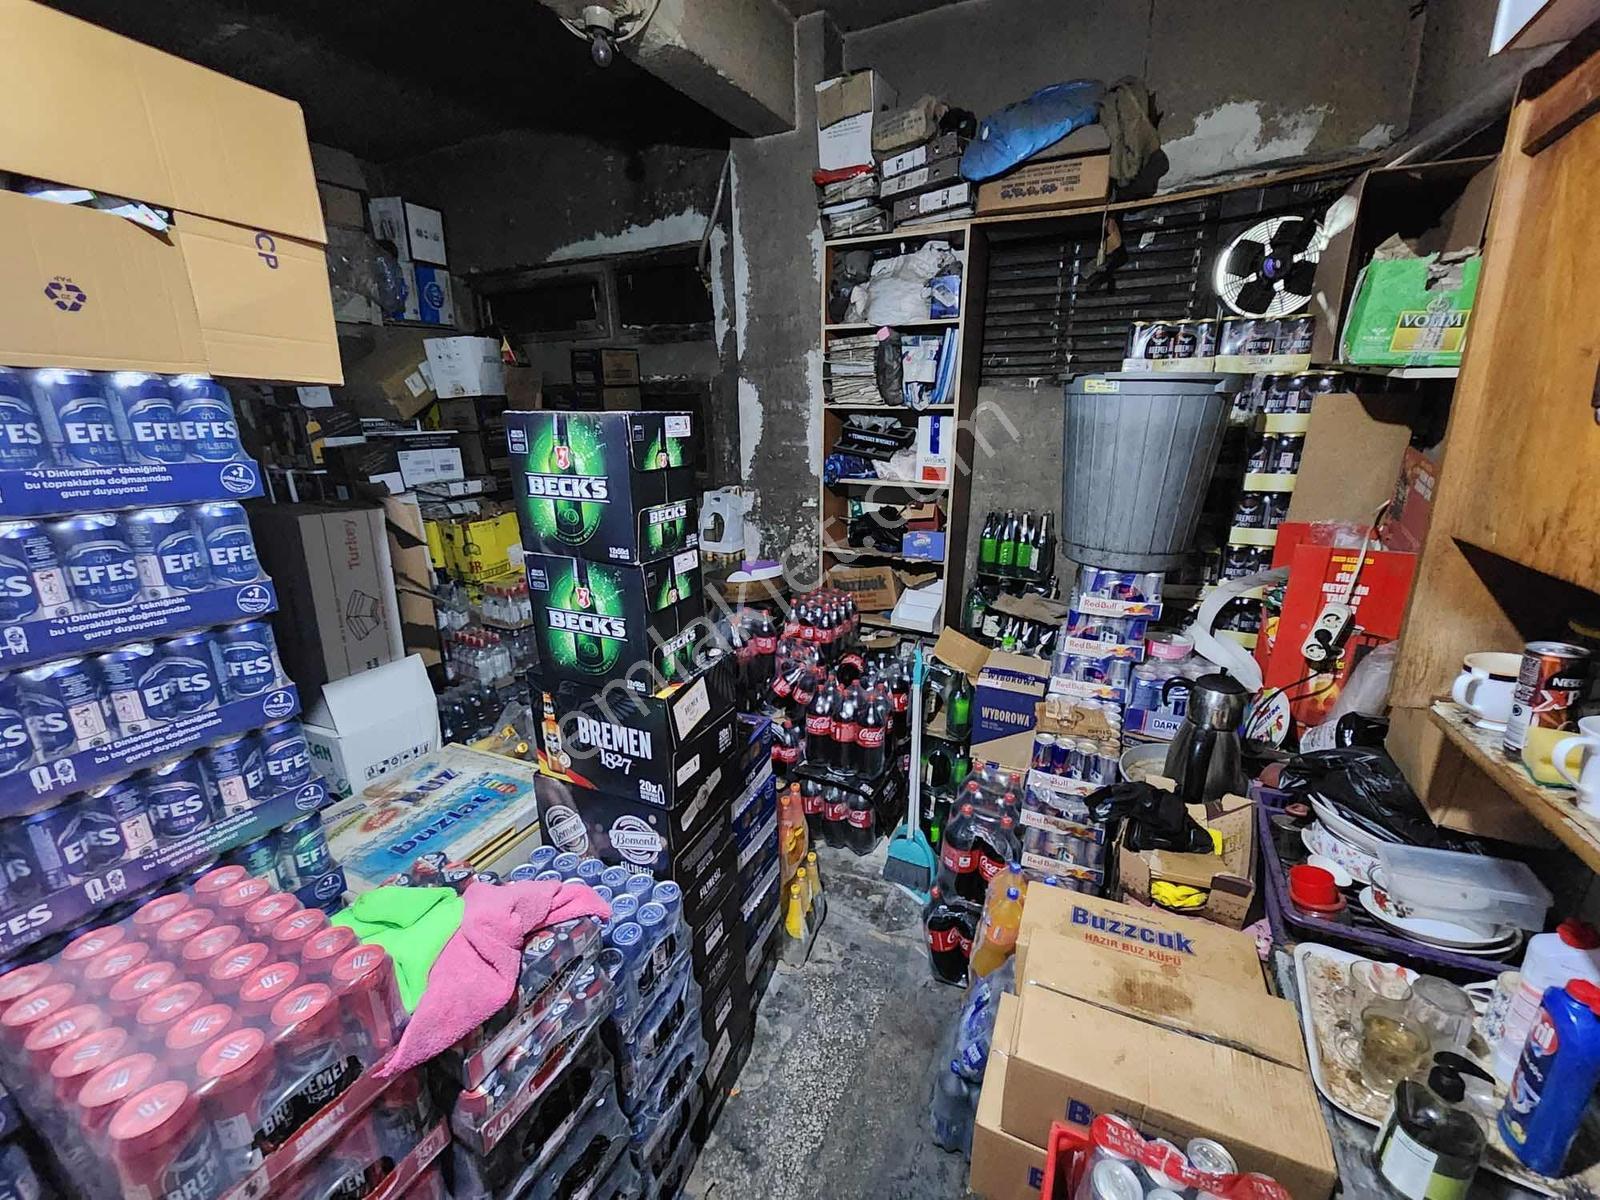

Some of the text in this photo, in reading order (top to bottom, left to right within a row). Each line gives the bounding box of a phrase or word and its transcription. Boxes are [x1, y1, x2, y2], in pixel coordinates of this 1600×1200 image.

[65, 422, 117, 443] EFE
[133, 421, 182, 441] EFE
[179, 421, 237, 440] EFES
[24, 474, 173, 490] bu topraklarda doğmasından
[47, 466, 117, 479] Dinlendirme"
[118, 465, 167, 475] tekniğinin
[60, 484, 149, 500] gurur duyuyoruz!
[528, 475, 608, 499] BECK'S
[649, 505, 687, 525] BECK'S
[210, 544, 254, 566] EFE
[344, 518, 360, 570] Turkey
[69, 558, 138, 586] EFES
[70, 605, 138, 624] Dinlendirme"
[140, 597, 186, 611] tekniğinin
[49, 628, 65, 638] bu
[67, 616, 128, 634] topraklarda
[83, 627, 112, 641] gurur
[549, 610, 627, 639] BECK'S
[226, 655, 273, 677] FES
[981, 706, 1030, 727] WYBOROWA
[577, 716, 653, 761] BREMEN
[95, 755, 109, 764] bu
[600, 748, 634, 775] 1827
[392, 794, 491, 857] buzlat
[614, 830, 658, 849] Bomonti
[1070, 905, 1195, 956] Buzzcuk
[1084, 933, 1183, 967] HAZIR BUZ KÜPÜ
